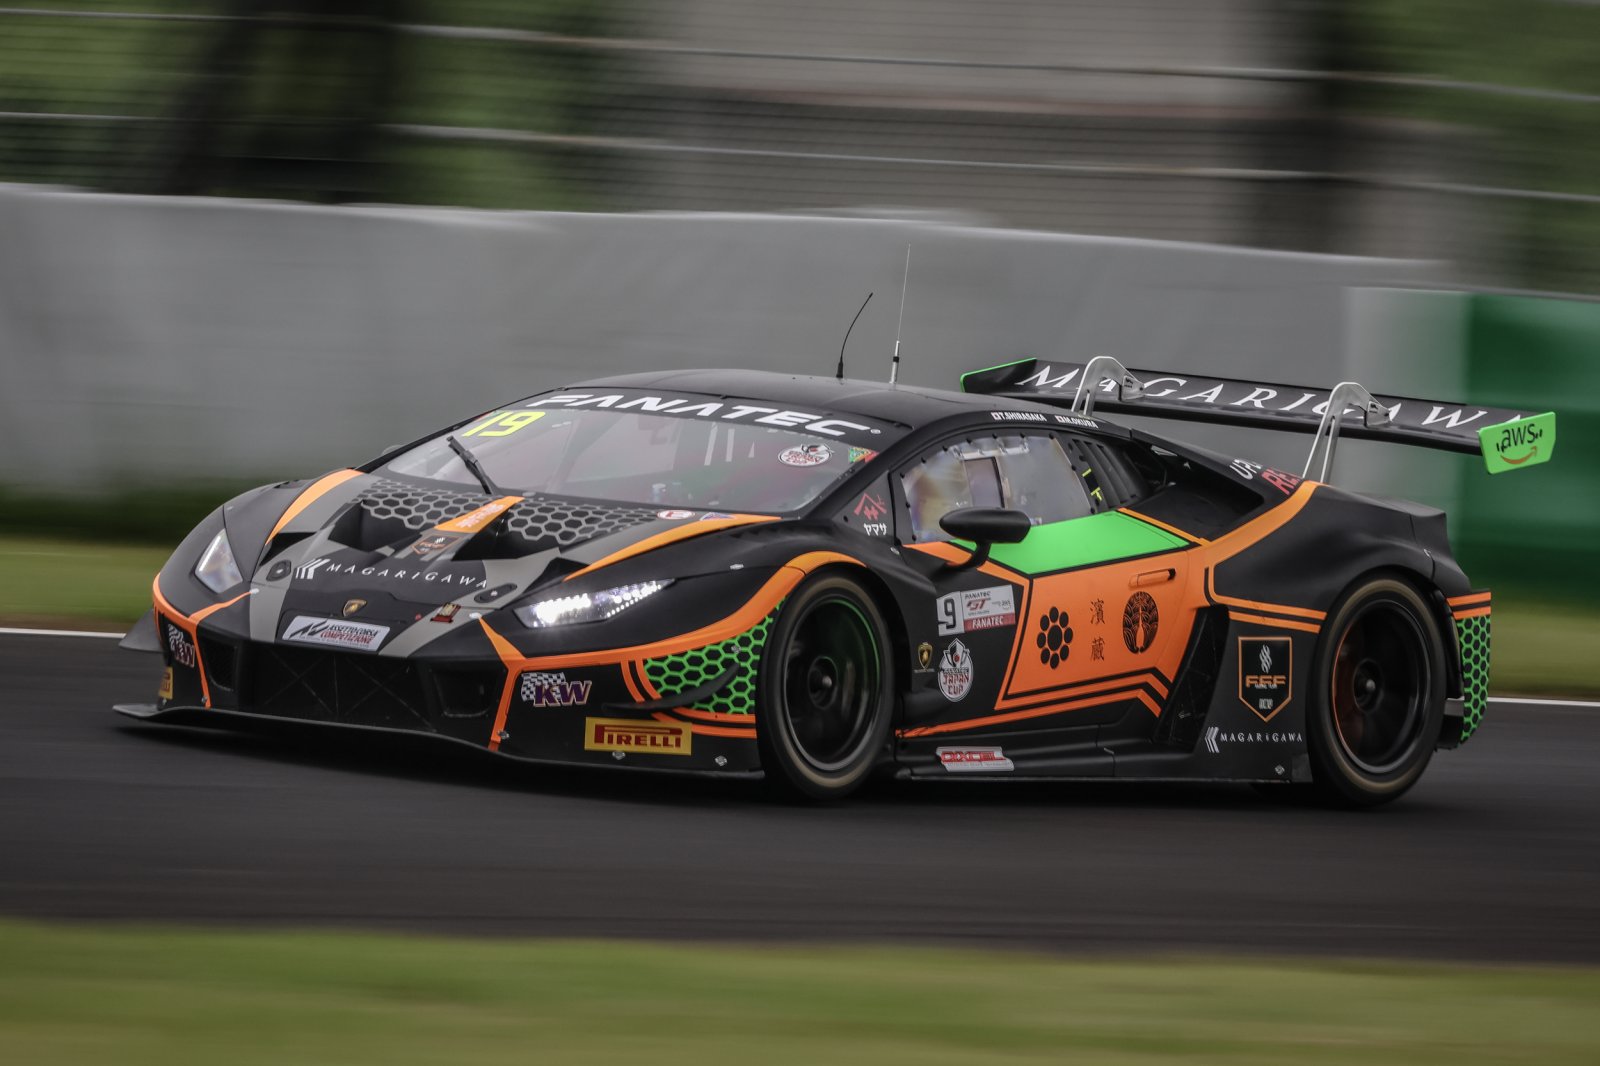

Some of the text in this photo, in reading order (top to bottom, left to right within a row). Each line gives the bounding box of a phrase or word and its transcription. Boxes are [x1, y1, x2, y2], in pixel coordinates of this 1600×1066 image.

[462, 411, 546, 437] 19
[526, 394, 870, 436] FANATEC
[1501, 423, 1537, 449] aws
[863, 522, 887, 536] ヤマサ
[326, 562, 487, 589] MAGARIGAWA
[972, 616, 1003, 629] FANATEC
[943, 672, 969, 685] JAPAN
[948, 684, 963, 696] CUP
[533, 680, 592, 707] KW
[594, 723, 683, 749] PIRELLI
[1220, 732, 1303, 743] MAGARIGAWA
